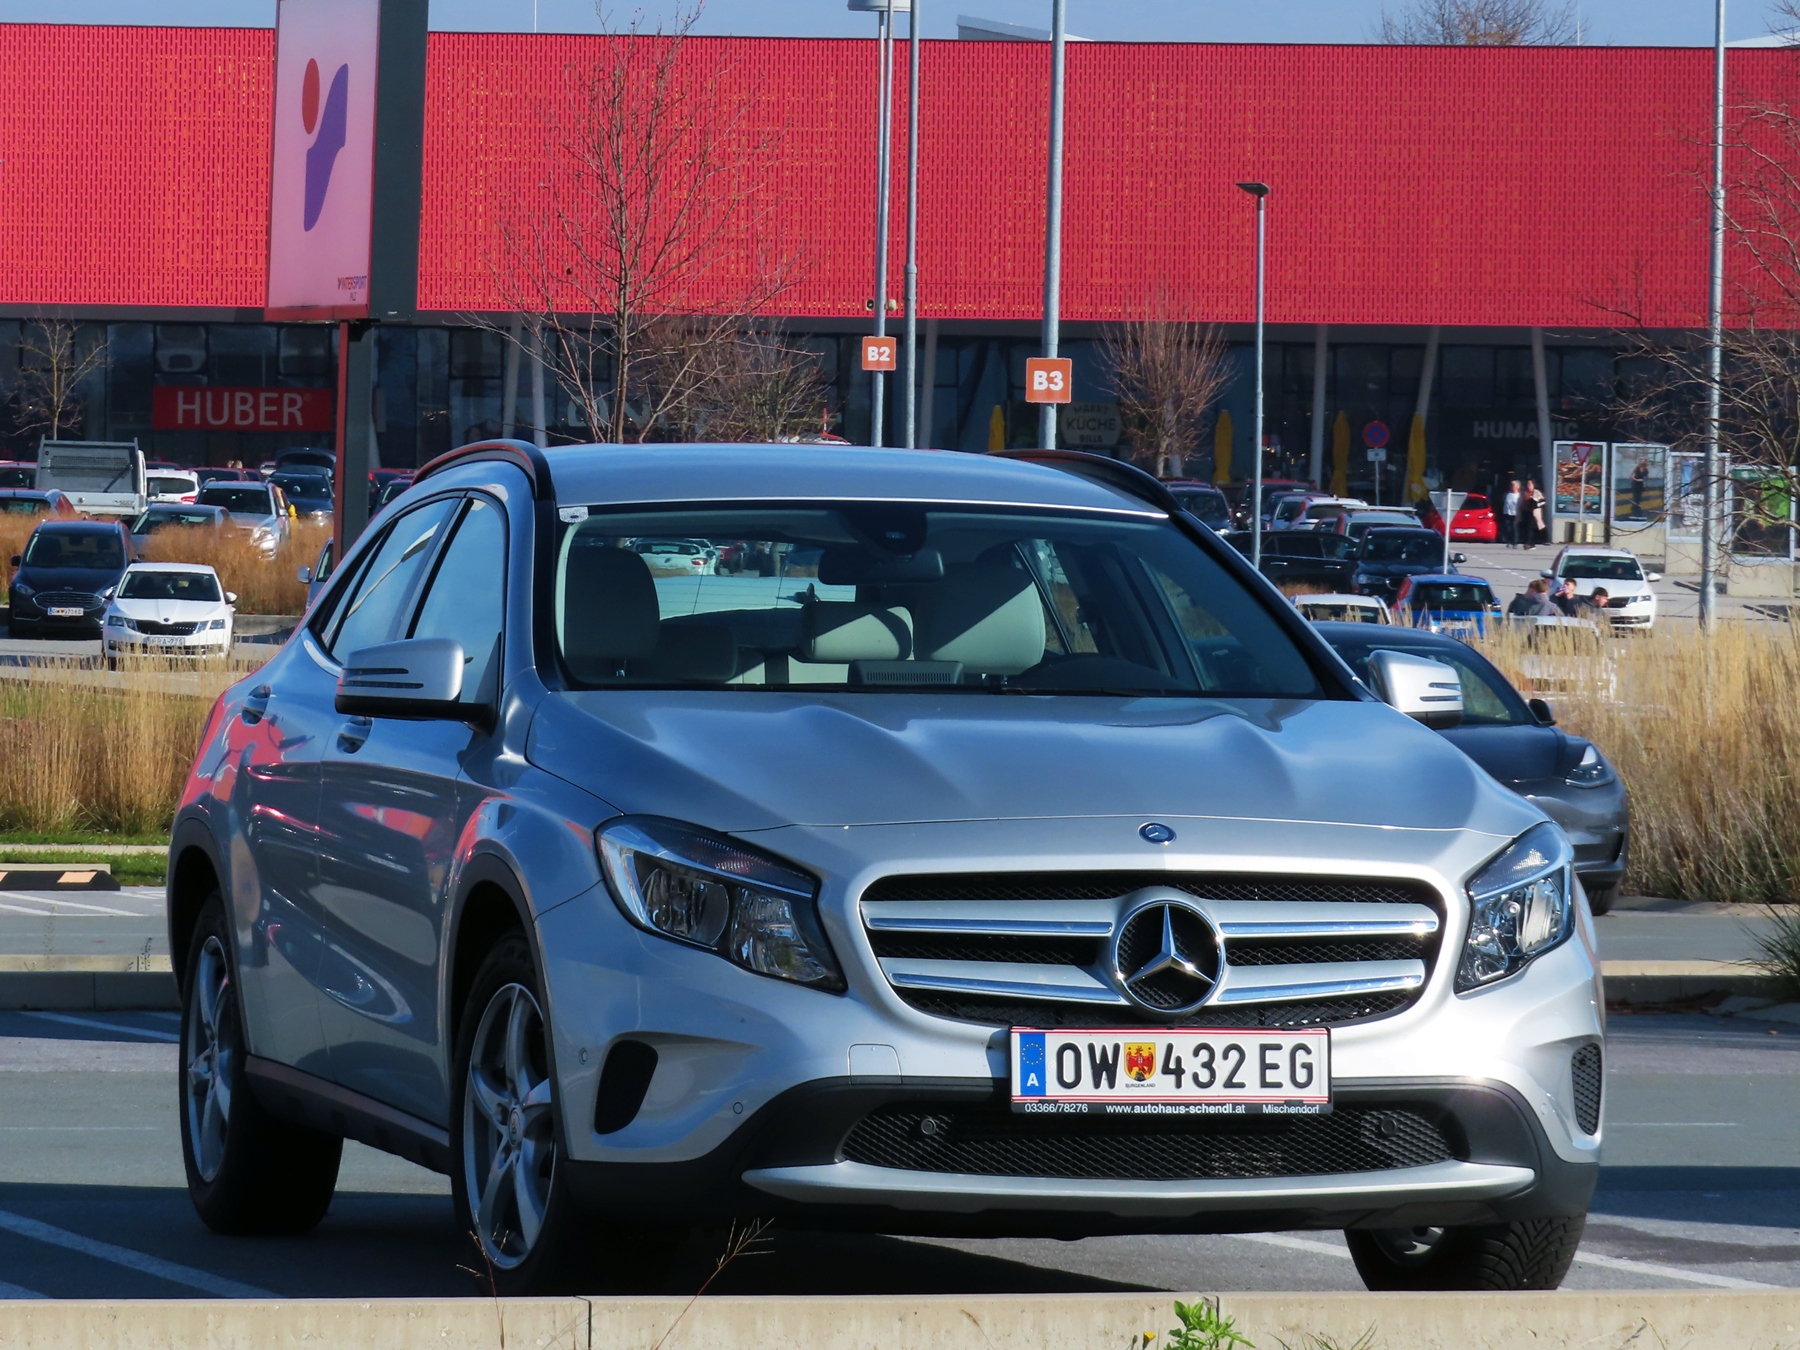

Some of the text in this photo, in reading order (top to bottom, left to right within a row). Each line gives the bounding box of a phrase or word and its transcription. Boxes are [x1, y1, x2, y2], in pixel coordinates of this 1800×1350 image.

[867, 346, 891, 362] B2
[1033, 370, 1064, 391] B3
[177, 391, 304, 426] HUBER
[1056, 1042, 1314, 1090] OW 432 EG
[1026, 1072, 1039, 1087] A
[1024, 1103, 1320, 1114] 03366/78276 www.autohaus-schendl.at Mischendorf
